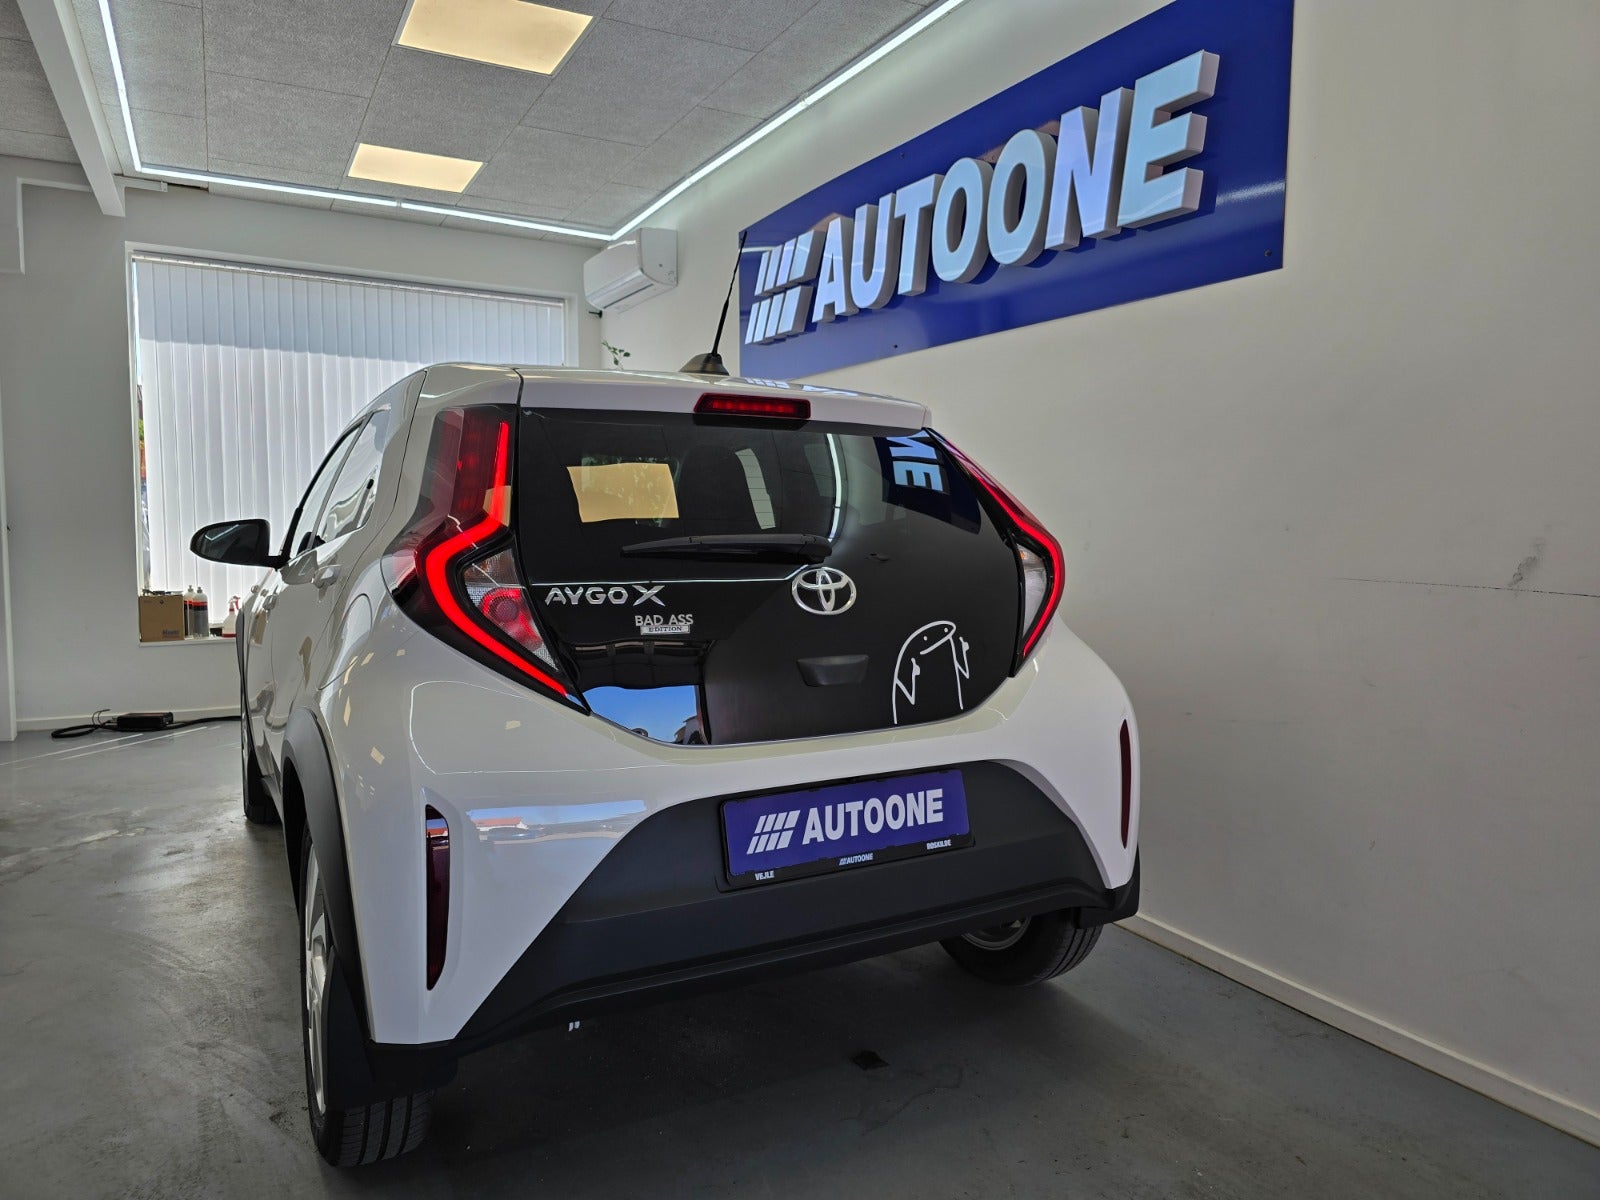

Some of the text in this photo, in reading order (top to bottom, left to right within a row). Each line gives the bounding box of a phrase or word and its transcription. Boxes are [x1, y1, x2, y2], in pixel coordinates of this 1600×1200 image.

[812, 49, 1218, 323] AUTOONE
[545, 585, 665, 607] AYGO X
[634, 614, 694, 626] BAD ASS
[802, 788, 943, 845] AUTOONE
[846, 853, 874, 864] AUTOONE
[755, 871, 775, 880] VEJLE
